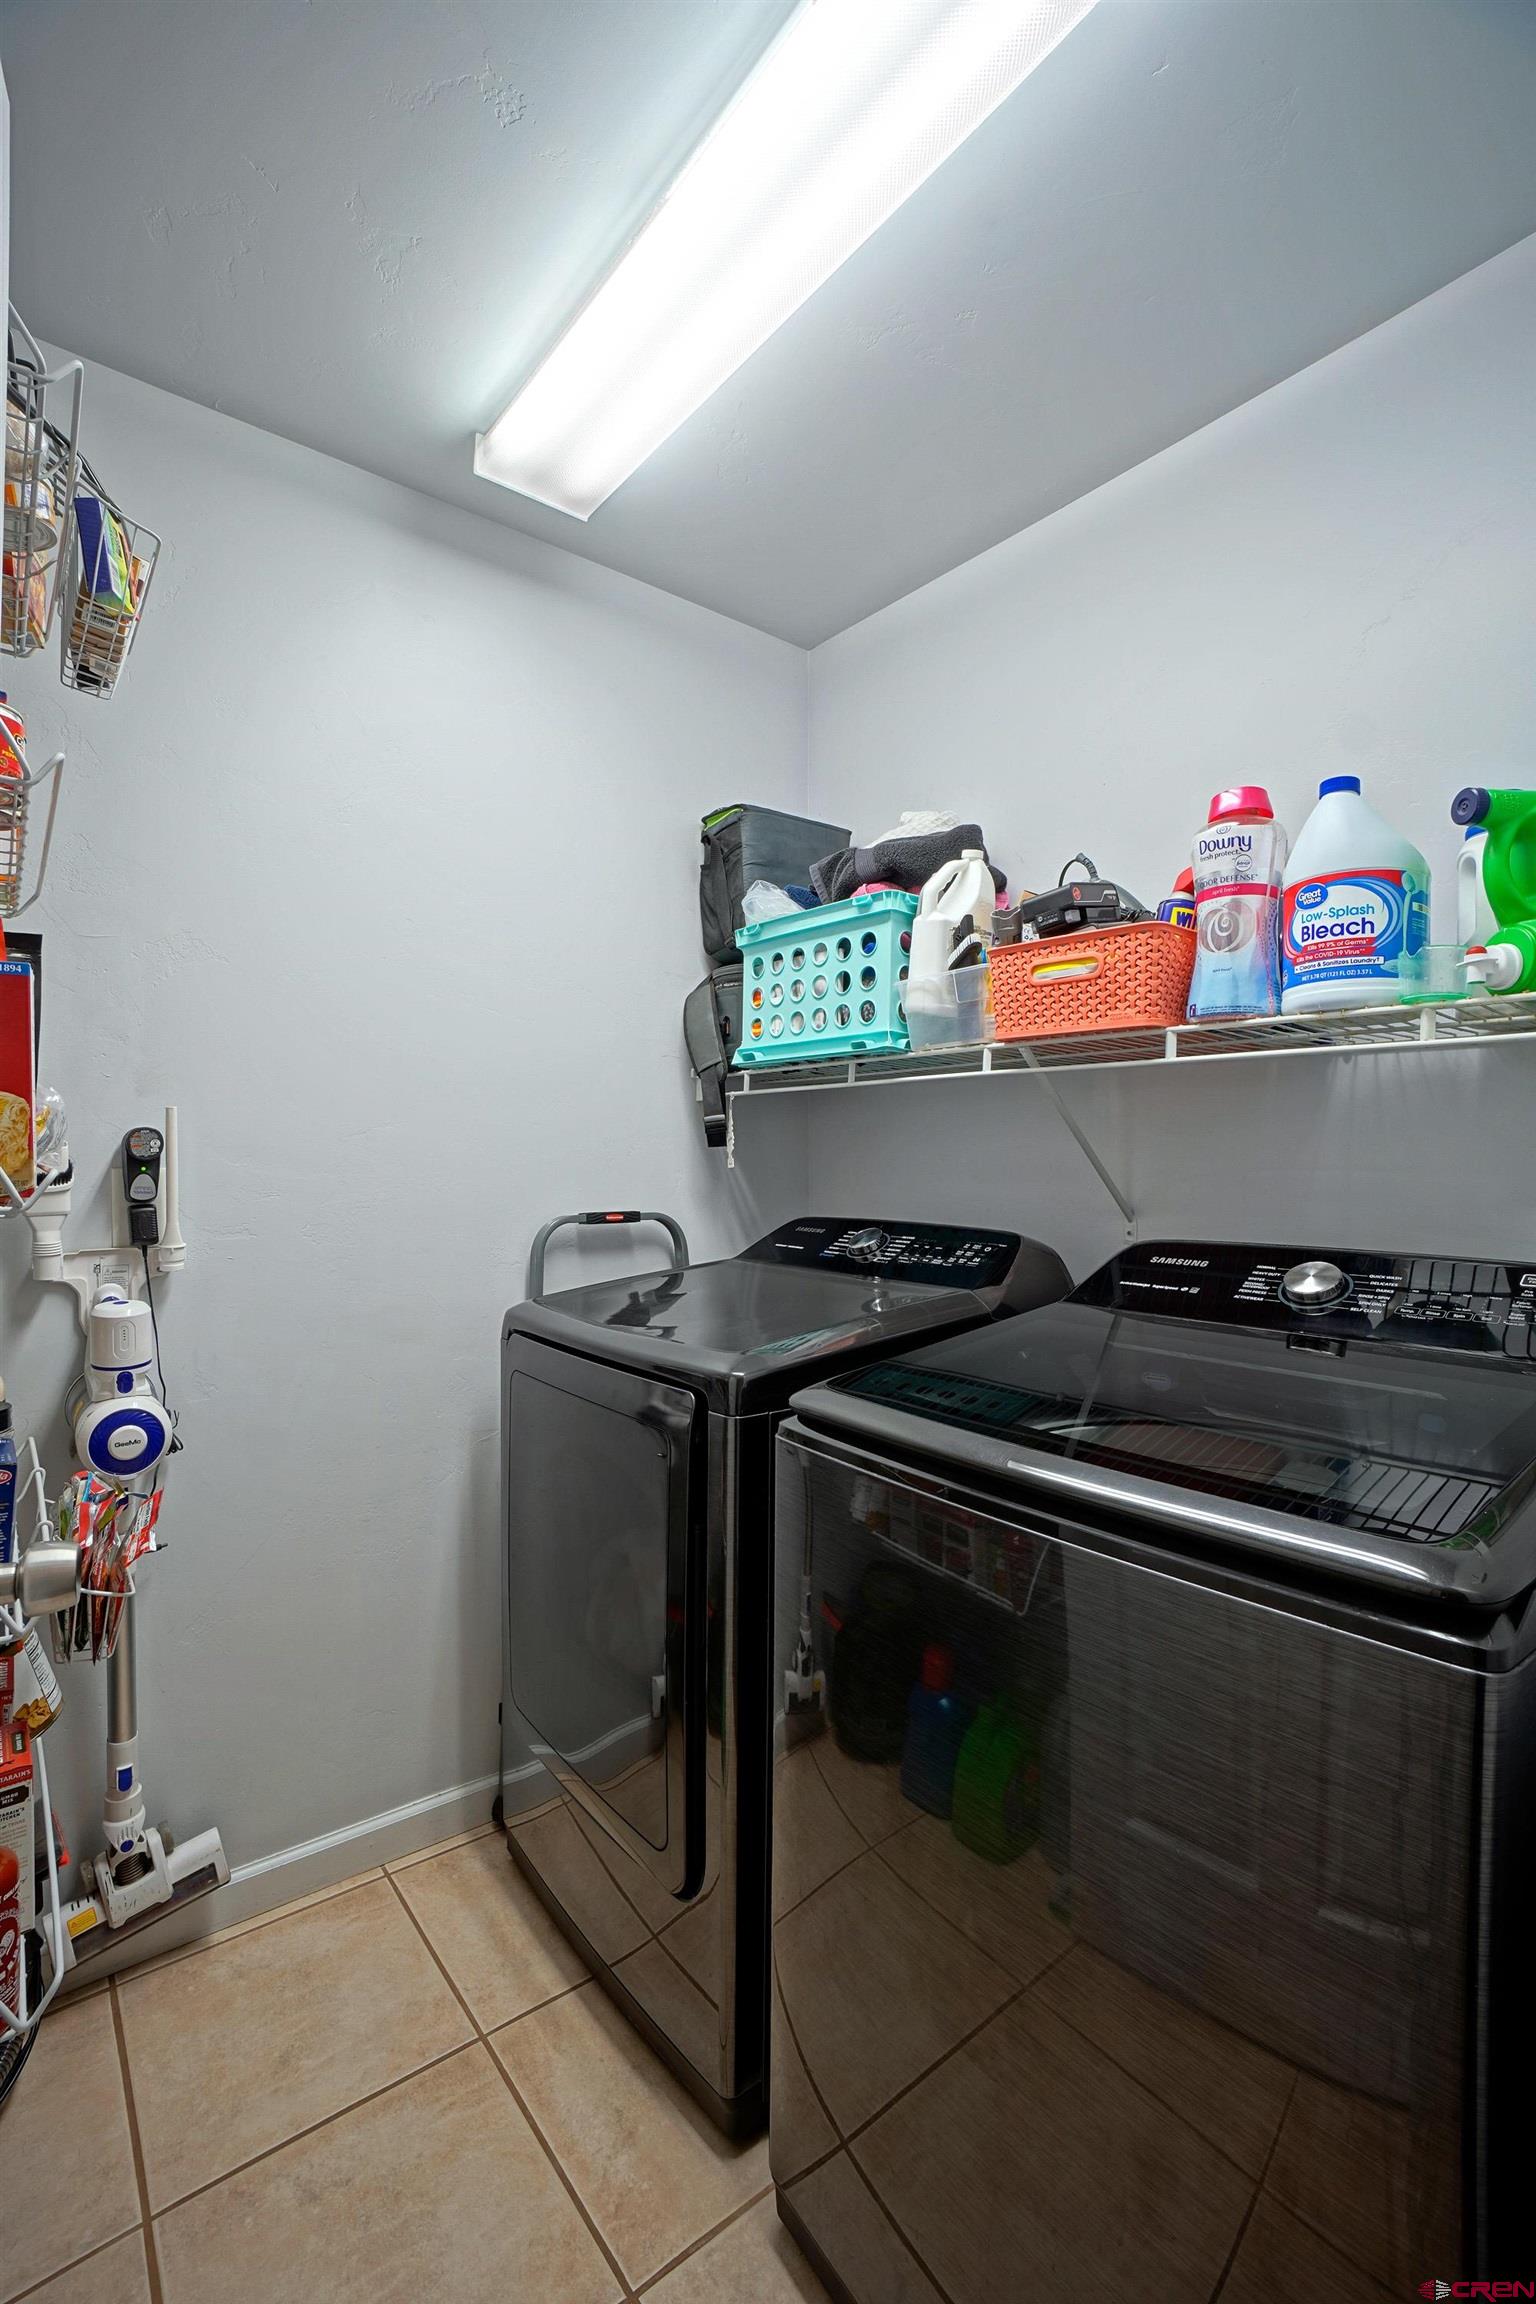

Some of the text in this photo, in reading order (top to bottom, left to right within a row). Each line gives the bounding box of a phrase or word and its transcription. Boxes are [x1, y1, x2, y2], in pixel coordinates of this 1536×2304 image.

[1199, 835, 1252, 855] Downy
[1299, 888, 1322, 901] Great
[1301, 903, 1375, 924] Low-Splash
[1301, 917, 1375, 943] Bleach
[1318, 941, 1335, 949] 99.9%
[1314, 949, 1343, 959] COVID-19
[0, 963, 22, 973] 1894
[1299, 963, 1317, 971] Cleans
[1321, 958, 1350, 967] Sanitizes
[1150, 1256, 1209, 1267] SAMSUNG
[114, 1439, 142, 1448] GeeMo
